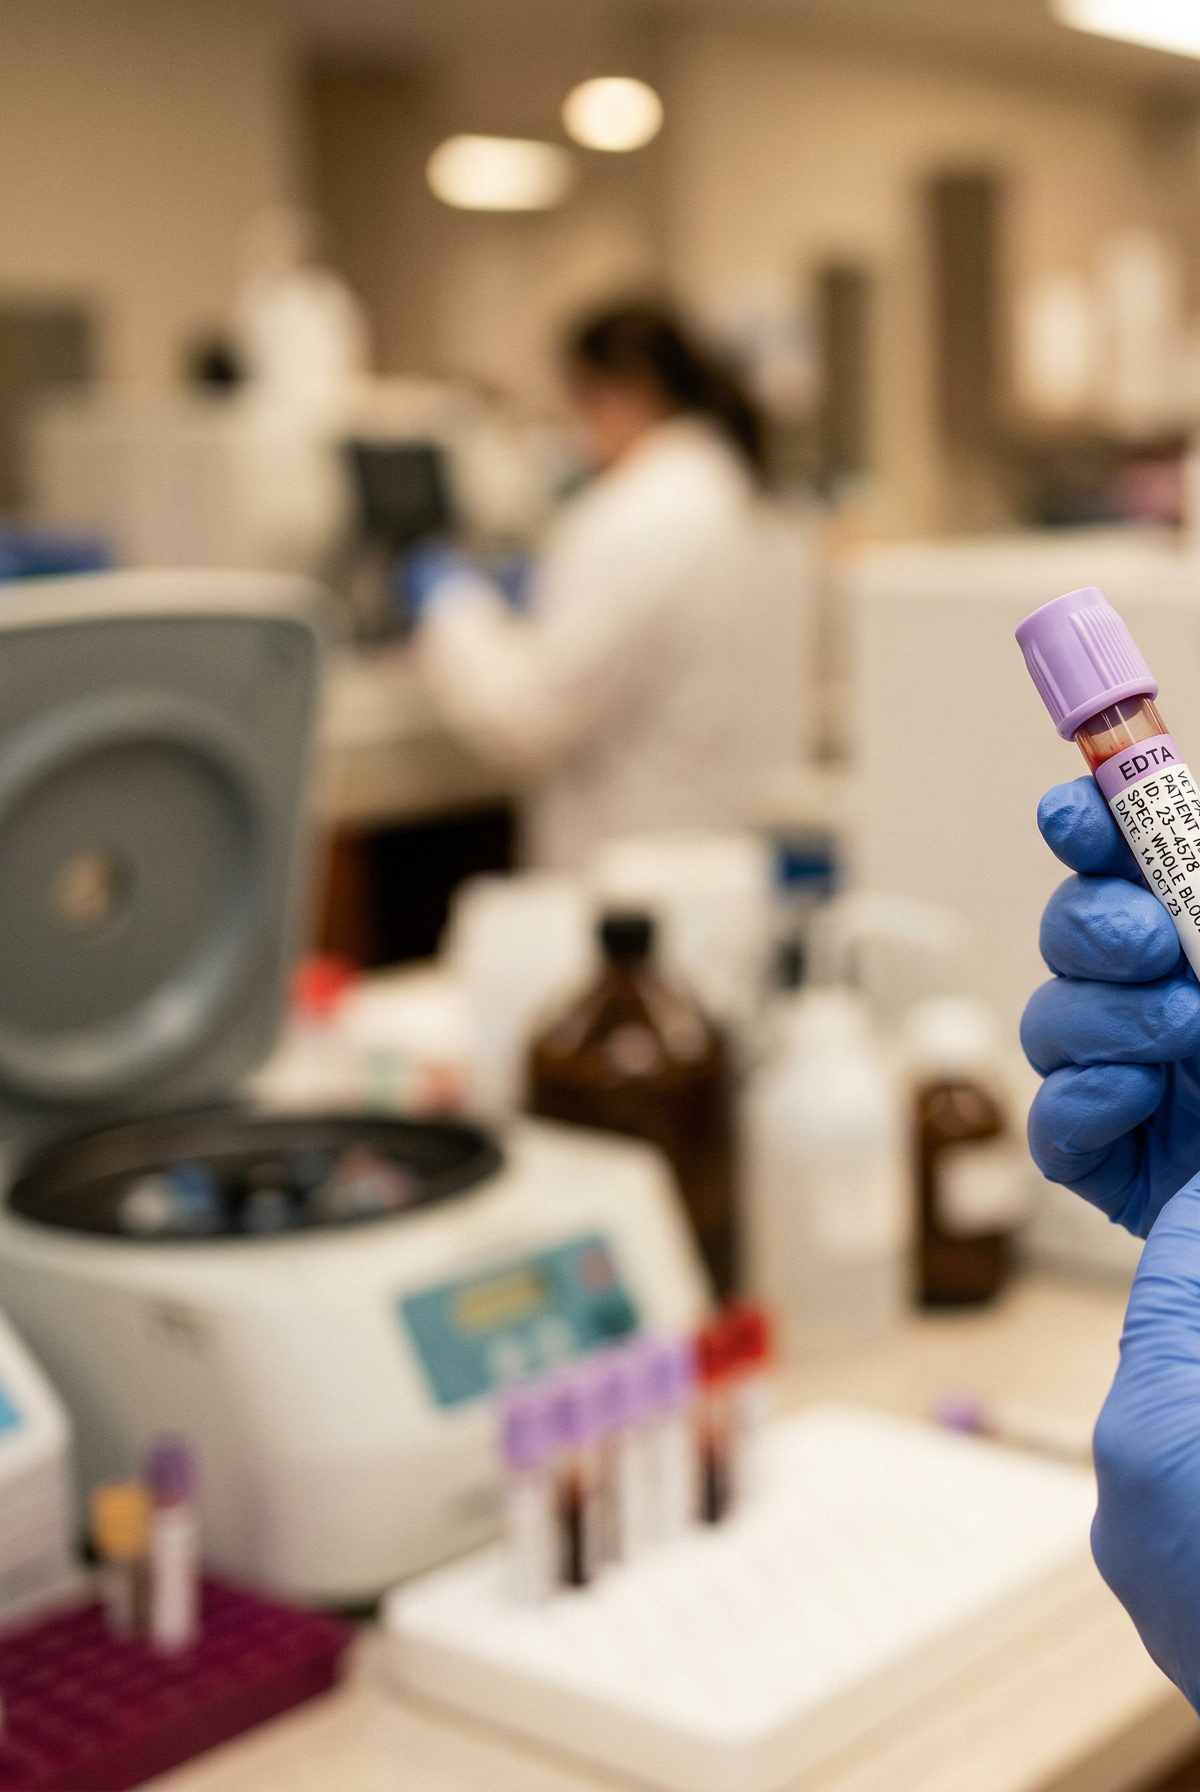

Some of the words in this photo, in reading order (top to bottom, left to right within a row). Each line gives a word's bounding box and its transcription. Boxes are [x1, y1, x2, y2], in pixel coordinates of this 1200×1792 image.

[1119, 745, 1175, 780] EDTA
[1177, 770, 1197, 796] VET
[1127, 789, 1154, 834] SPEC:
[1151, 832, 1186, 887] WHOLE
[1143, 780, 1160, 804] ID:
[1156, 806, 1200, 873] 23-4578
[1160, 774, 1200, 832] PATIENT
[1115, 799, 1141, 843] DATE:
[1152, 869, 1173, 898] OCT
[1166, 898, 1182, 917] 23
